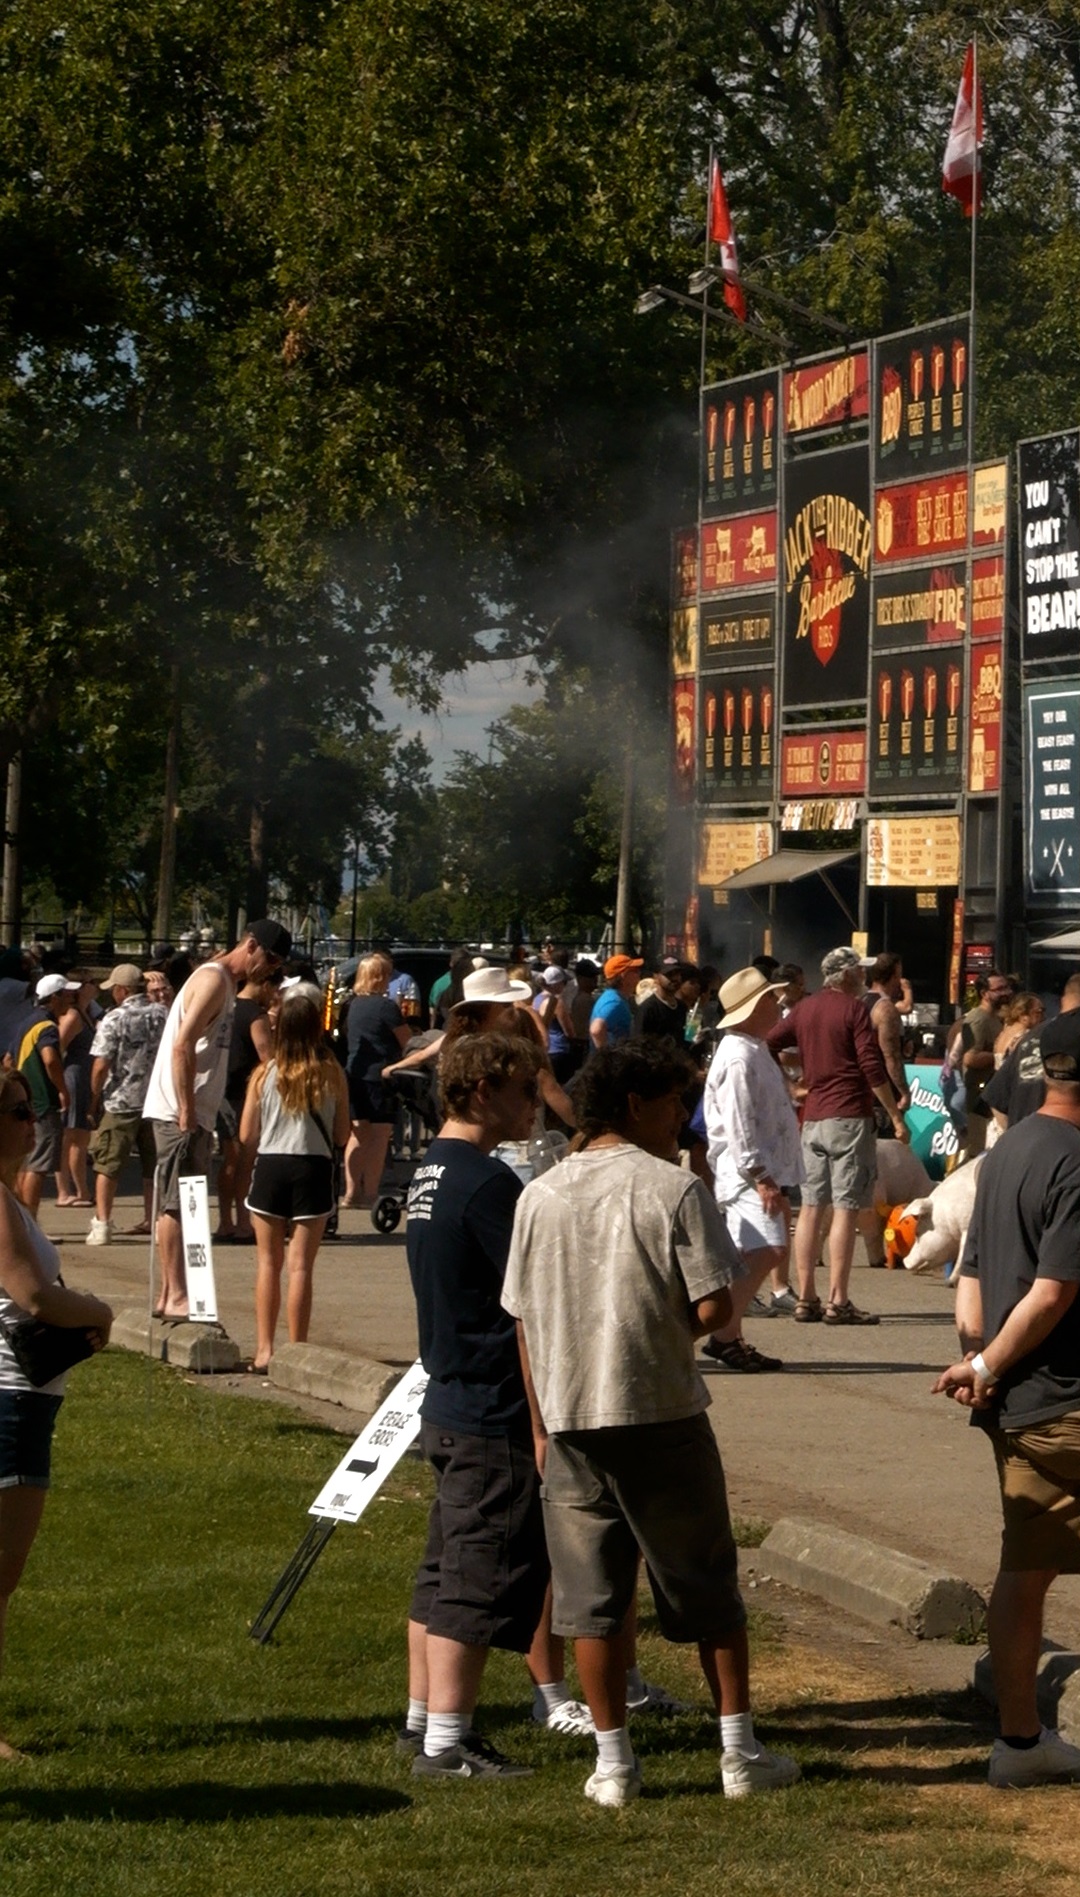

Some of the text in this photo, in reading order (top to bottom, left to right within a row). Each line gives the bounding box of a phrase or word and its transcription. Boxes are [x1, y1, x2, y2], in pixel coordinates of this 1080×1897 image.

[1025, 480, 1049, 509] YOU
[785, 504, 814, 592] JACK
[826, 494, 871, 580] RIBBER
[1026, 517, 1060, 548] CAN'T
[1026, 551, 1078, 584] STOP THE
[934, 587, 967, 630] FIRE
[980, 664, 1002, 700] BBQ
